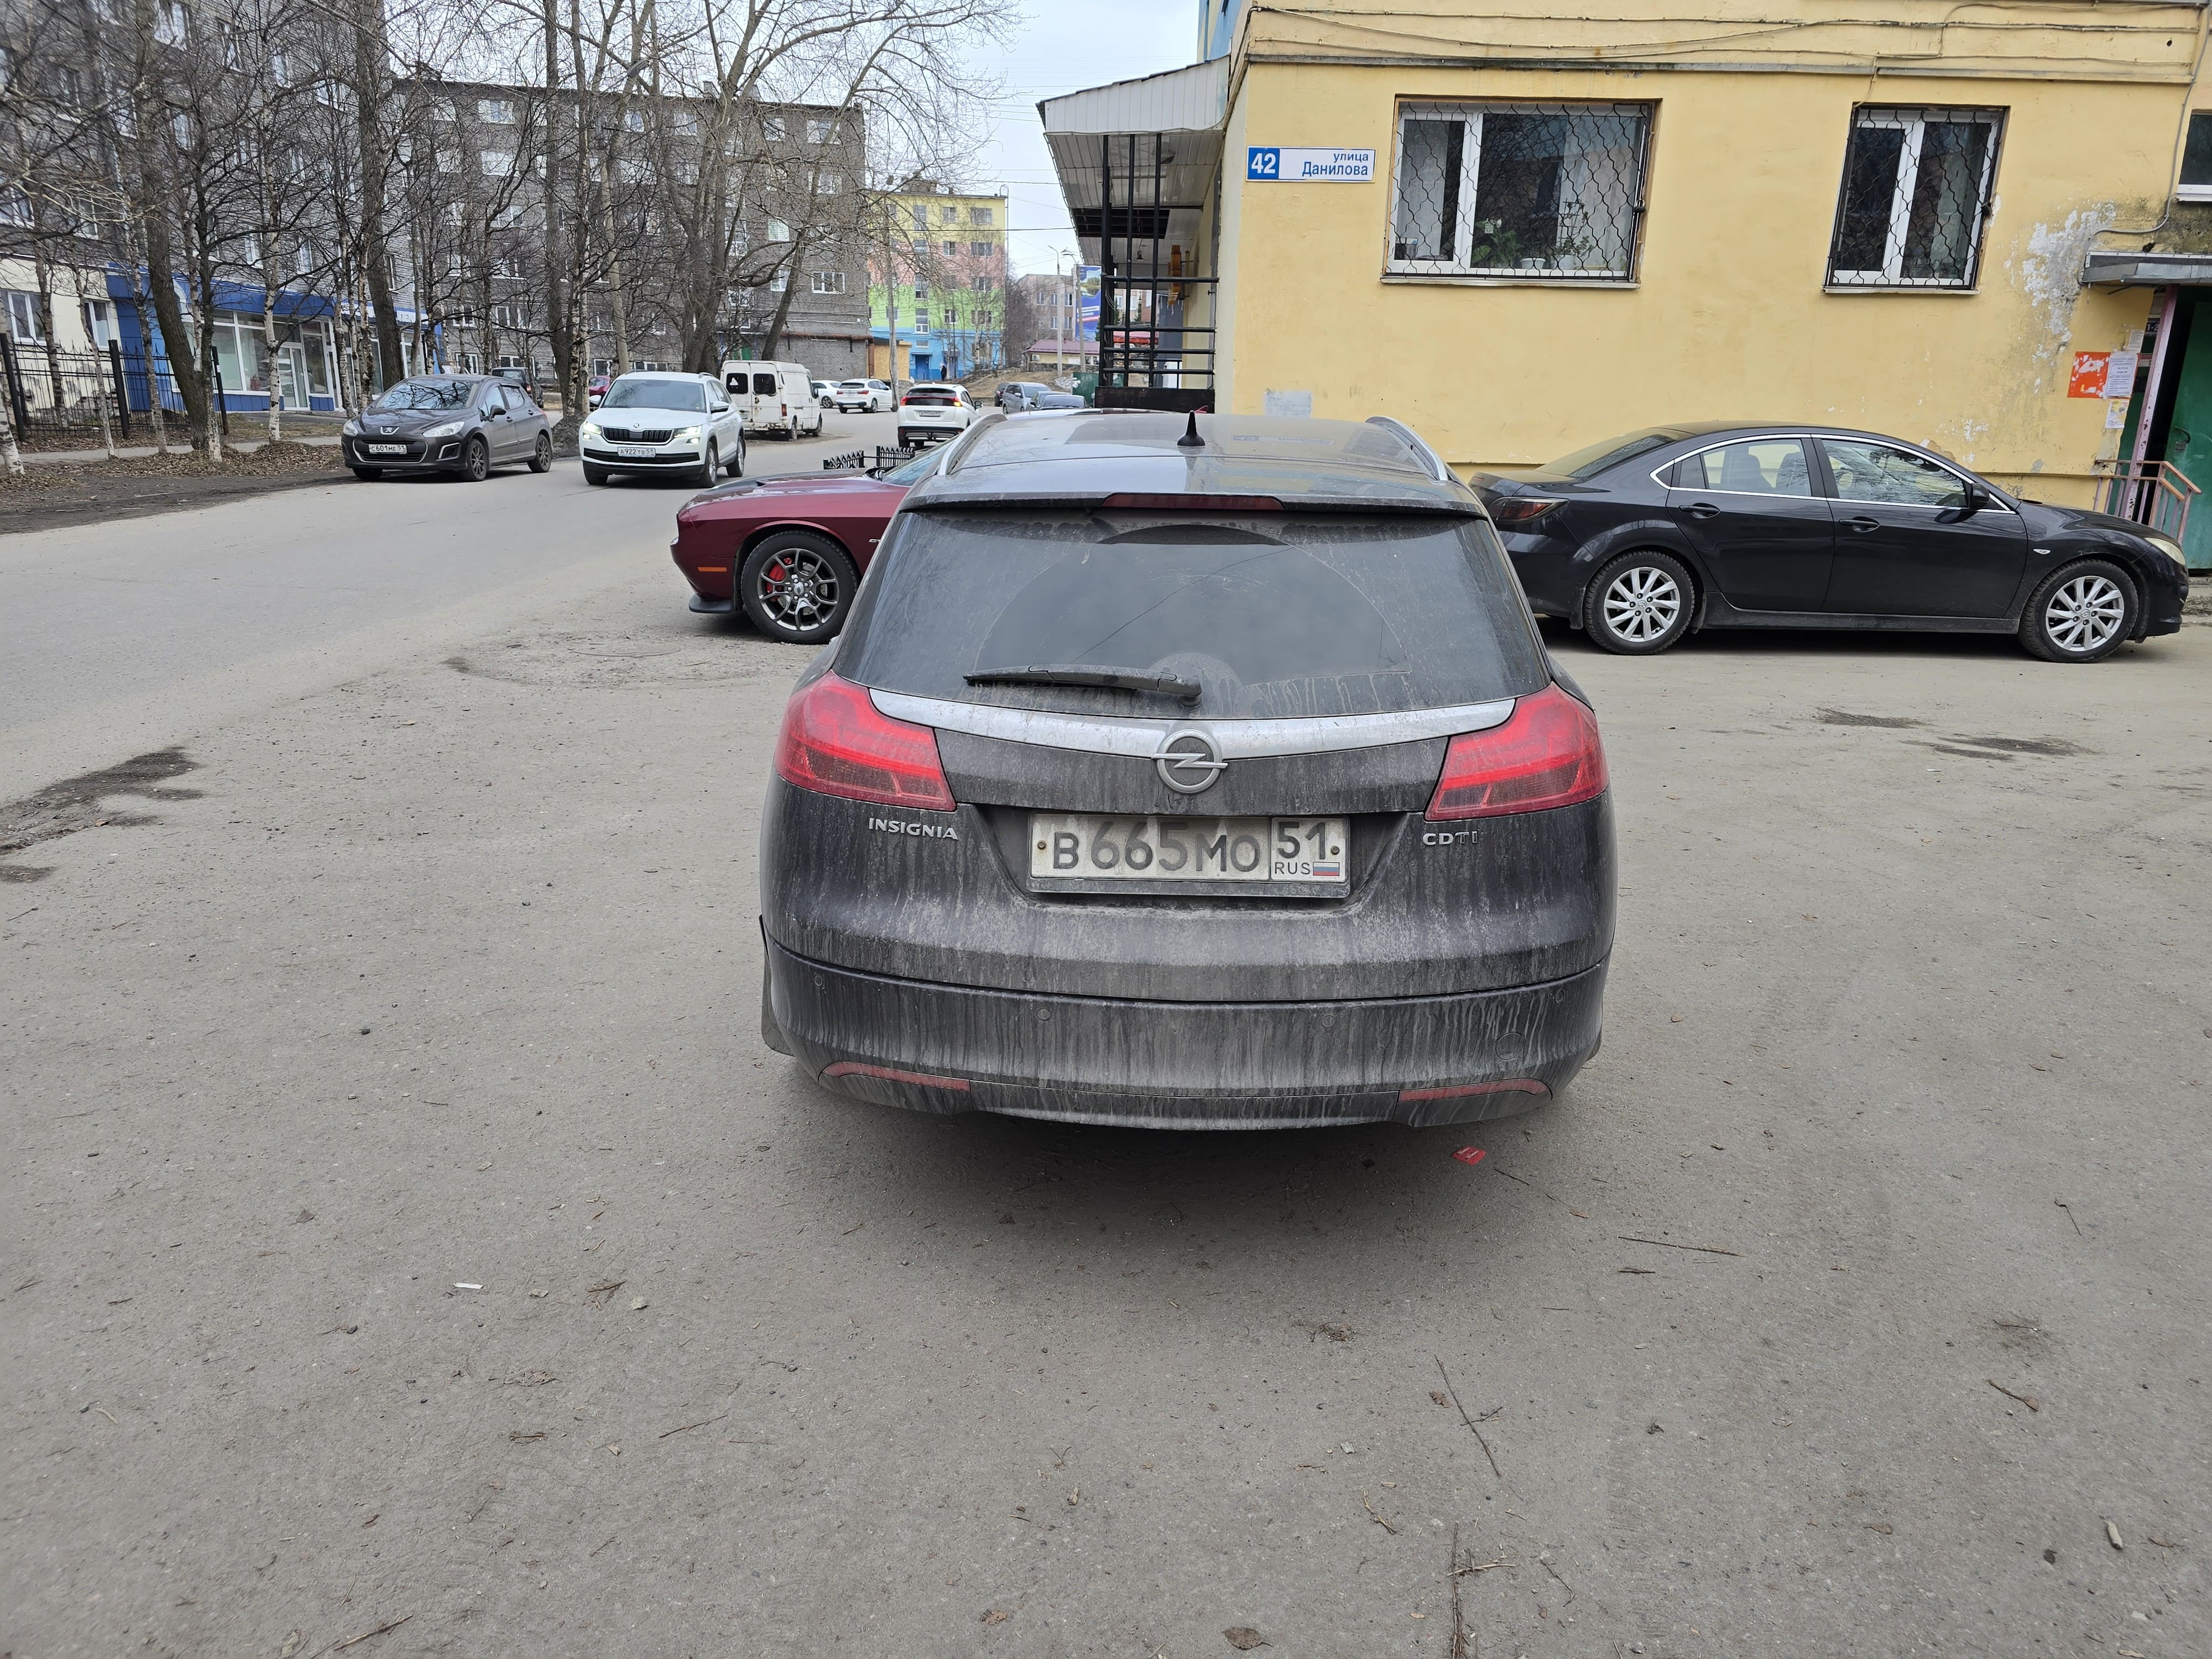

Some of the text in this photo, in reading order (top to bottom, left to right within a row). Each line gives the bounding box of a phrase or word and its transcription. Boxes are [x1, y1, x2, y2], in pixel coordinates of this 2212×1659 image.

[1251, 153, 1276, 174] 42
[1333, 153, 1369, 163] улица
[1302, 161, 1368, 177] Данилова
[868, 817, 960, 841] INSIGNIA
[1277, 822, 1327, 860] 51
[1422, 831, 1478, 846] CDTI
[1274, 862, 1311, 875] RUS
